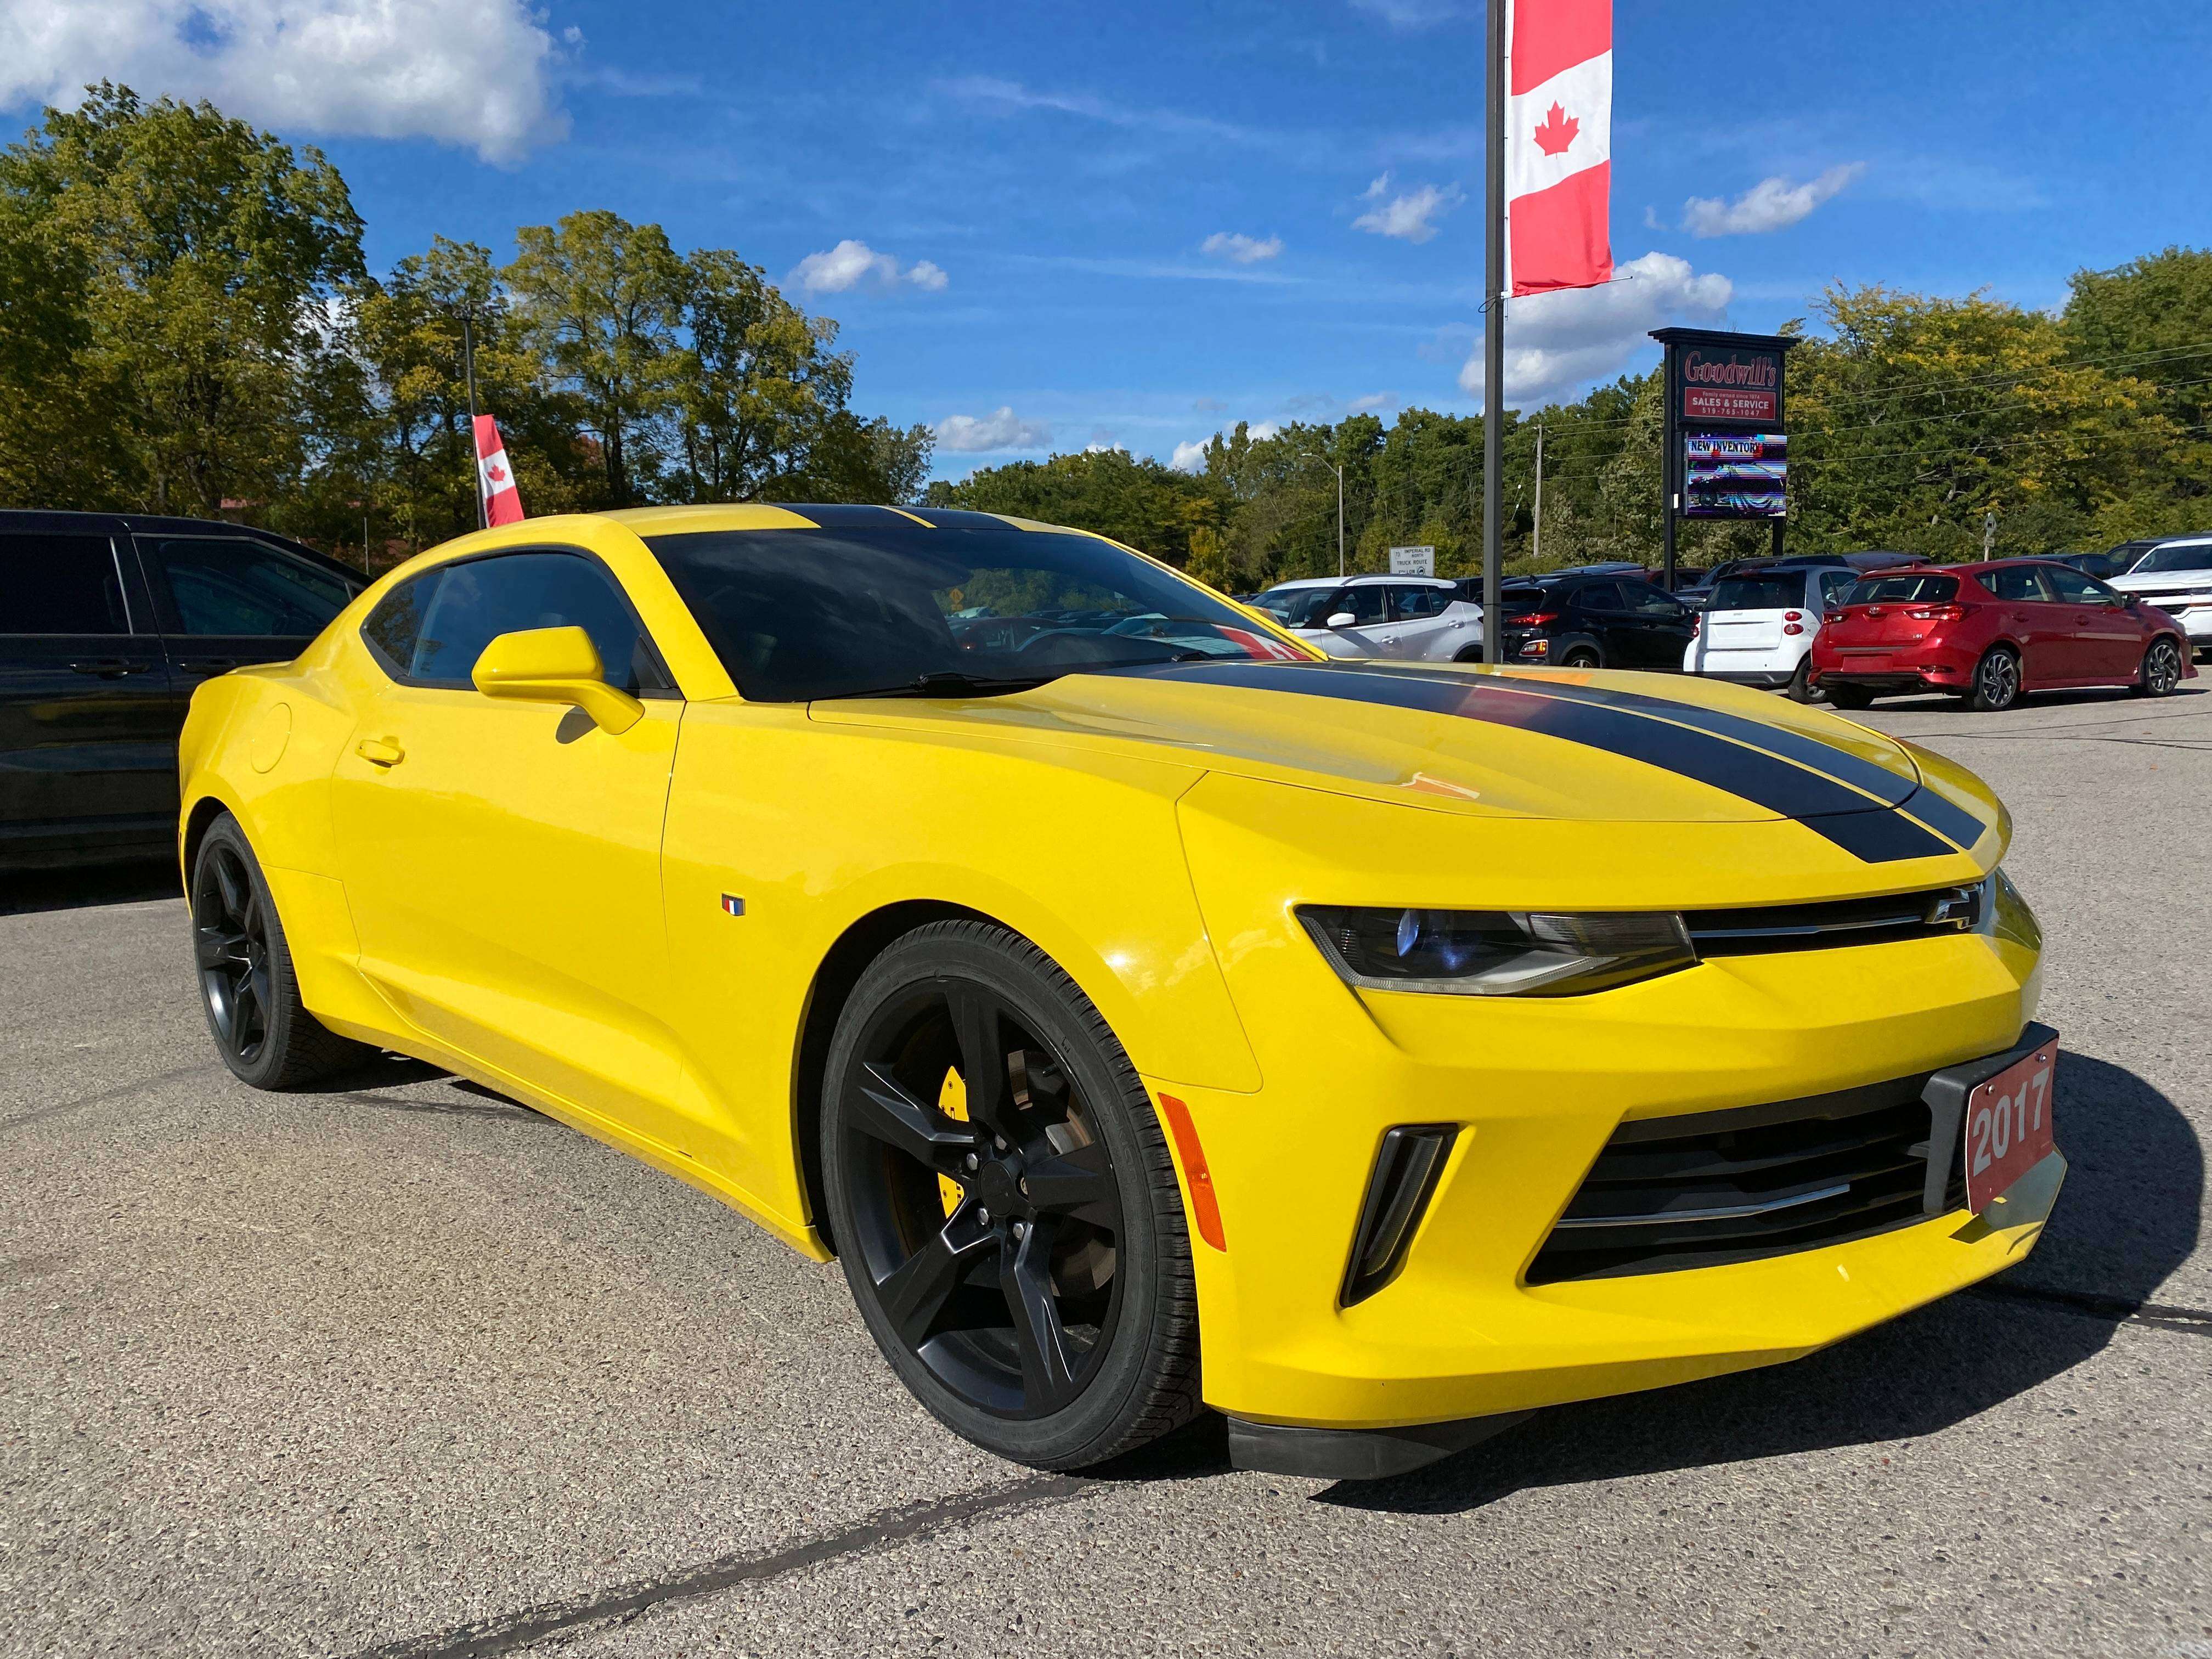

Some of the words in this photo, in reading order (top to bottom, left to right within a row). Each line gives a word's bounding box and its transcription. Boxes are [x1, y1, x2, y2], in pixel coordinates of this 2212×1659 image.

[1685, 351, 1776, 387] Goodwill's
[1692, 397, 1721, 407] SALES
[1724, 399, 1730, 407] &
[1733, 400, 1769, 409] SERVICE
[1702, 408, 1759, 416] 519-765-1047
[1691, 440, 1711, 452] NEW
[1973, 1066, 2050, 1177] 2017
